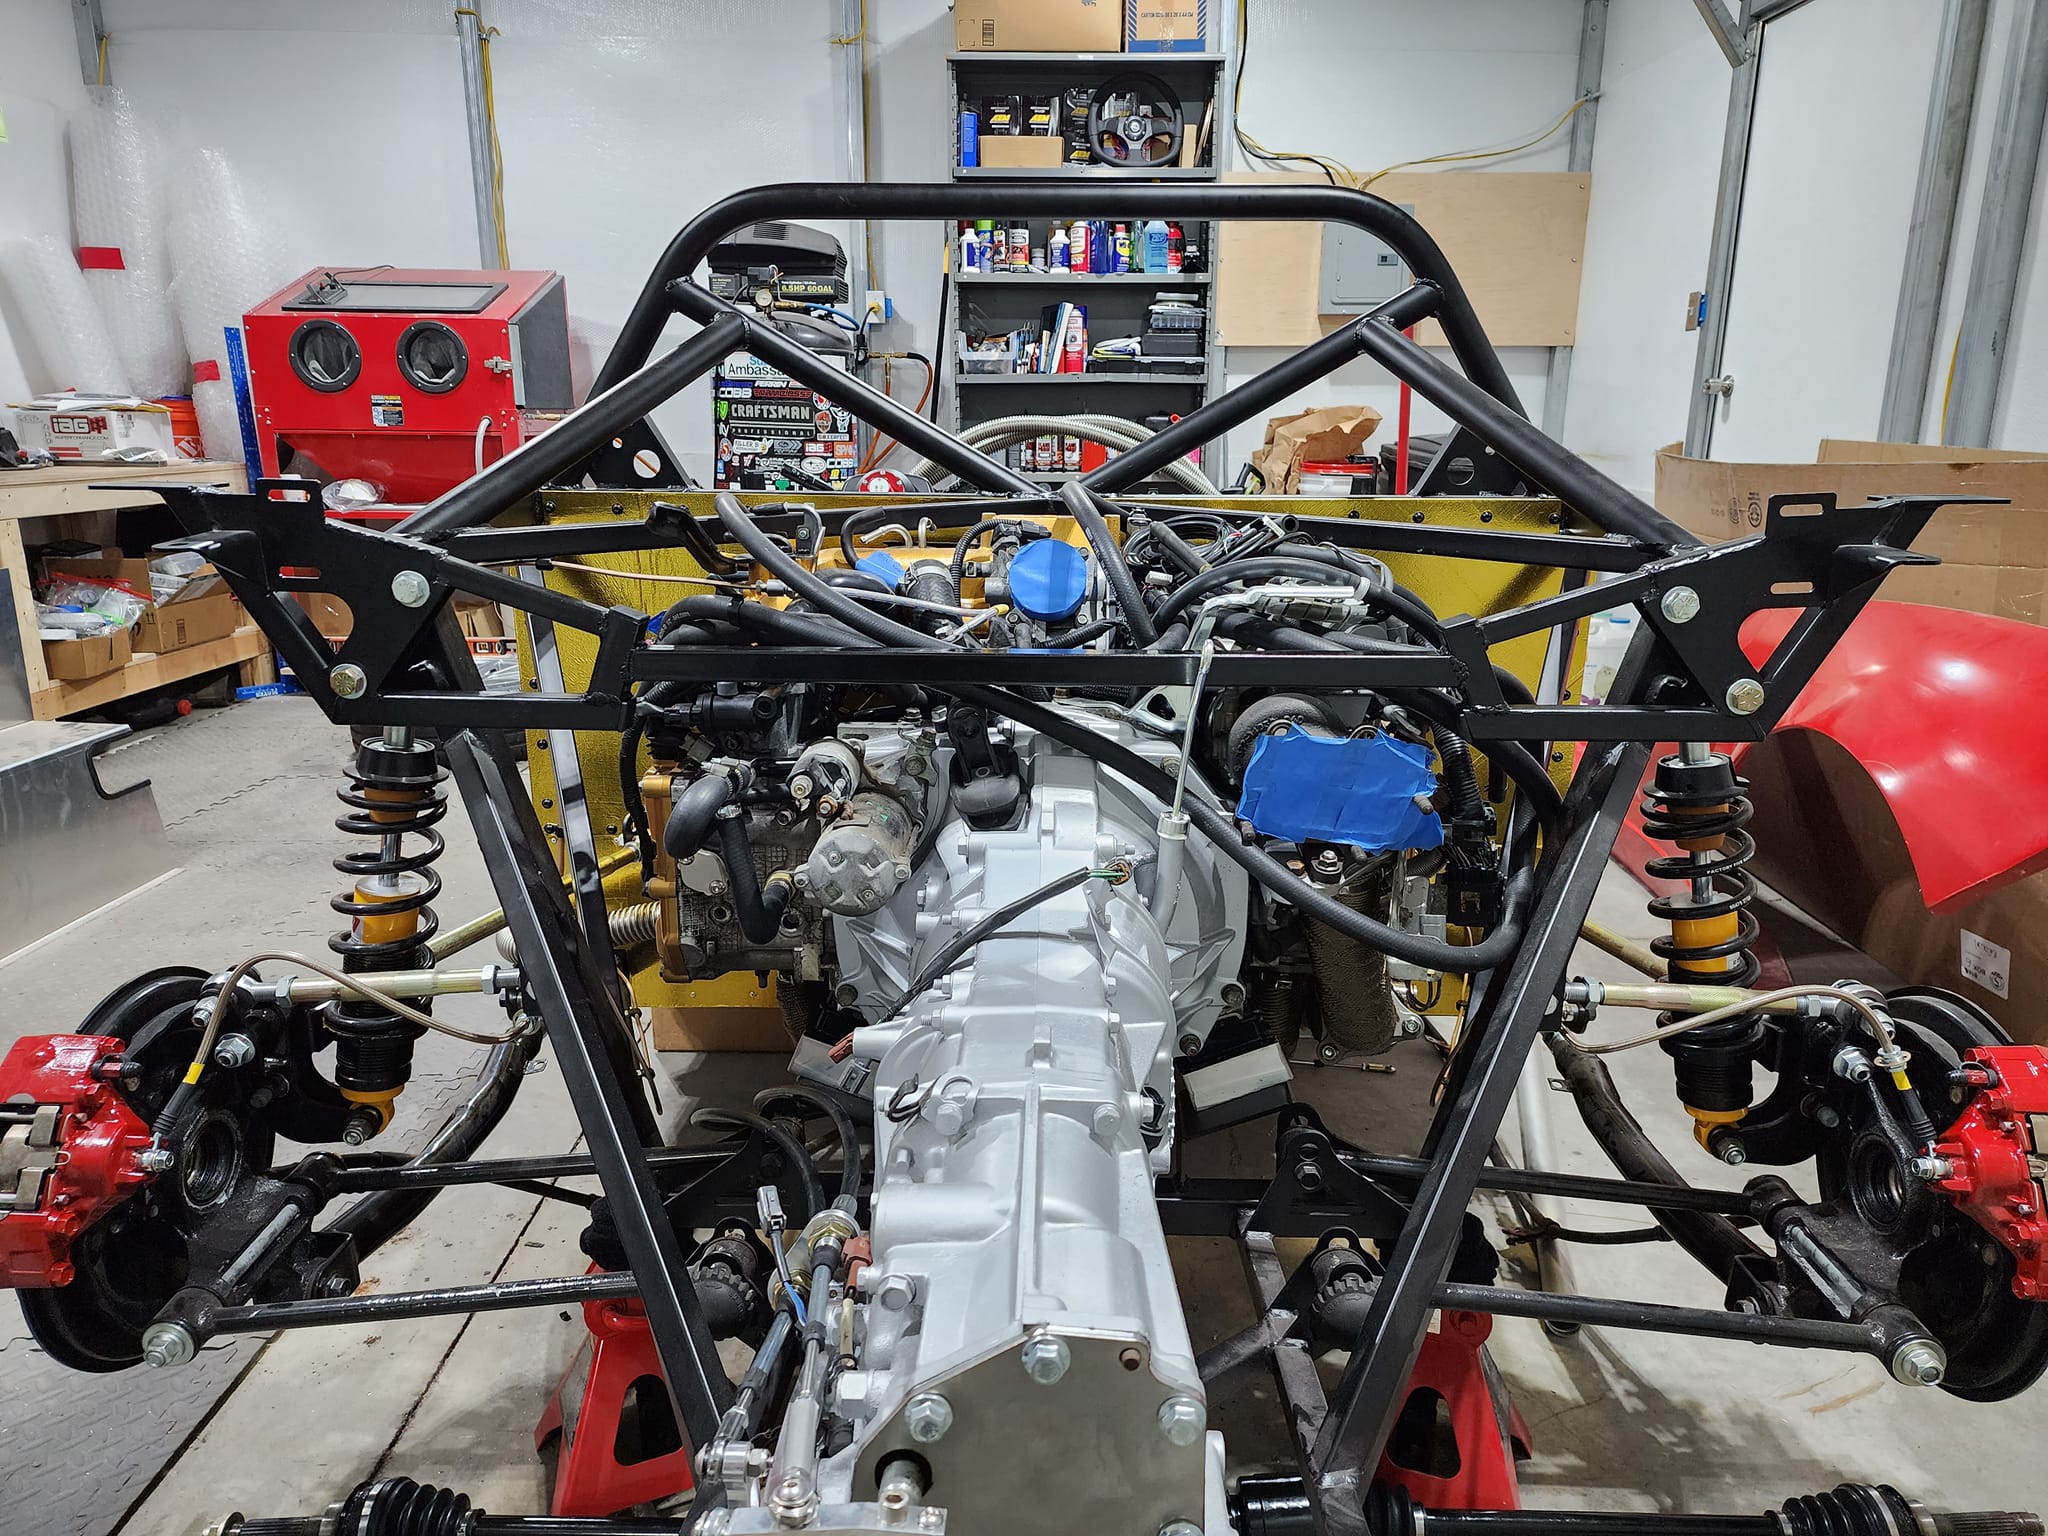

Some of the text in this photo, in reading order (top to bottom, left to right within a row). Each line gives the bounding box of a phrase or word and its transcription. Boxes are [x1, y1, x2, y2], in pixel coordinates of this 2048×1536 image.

[728, 363, 785, 376] Ambassa
[720, 388, 752, 398] COBB
[731, 404, 810, 420] CRAFTSMAN
[732, 428, 810, 436] PROFESSIONAL
[1706, 864, 1732, 874] FACTORY
